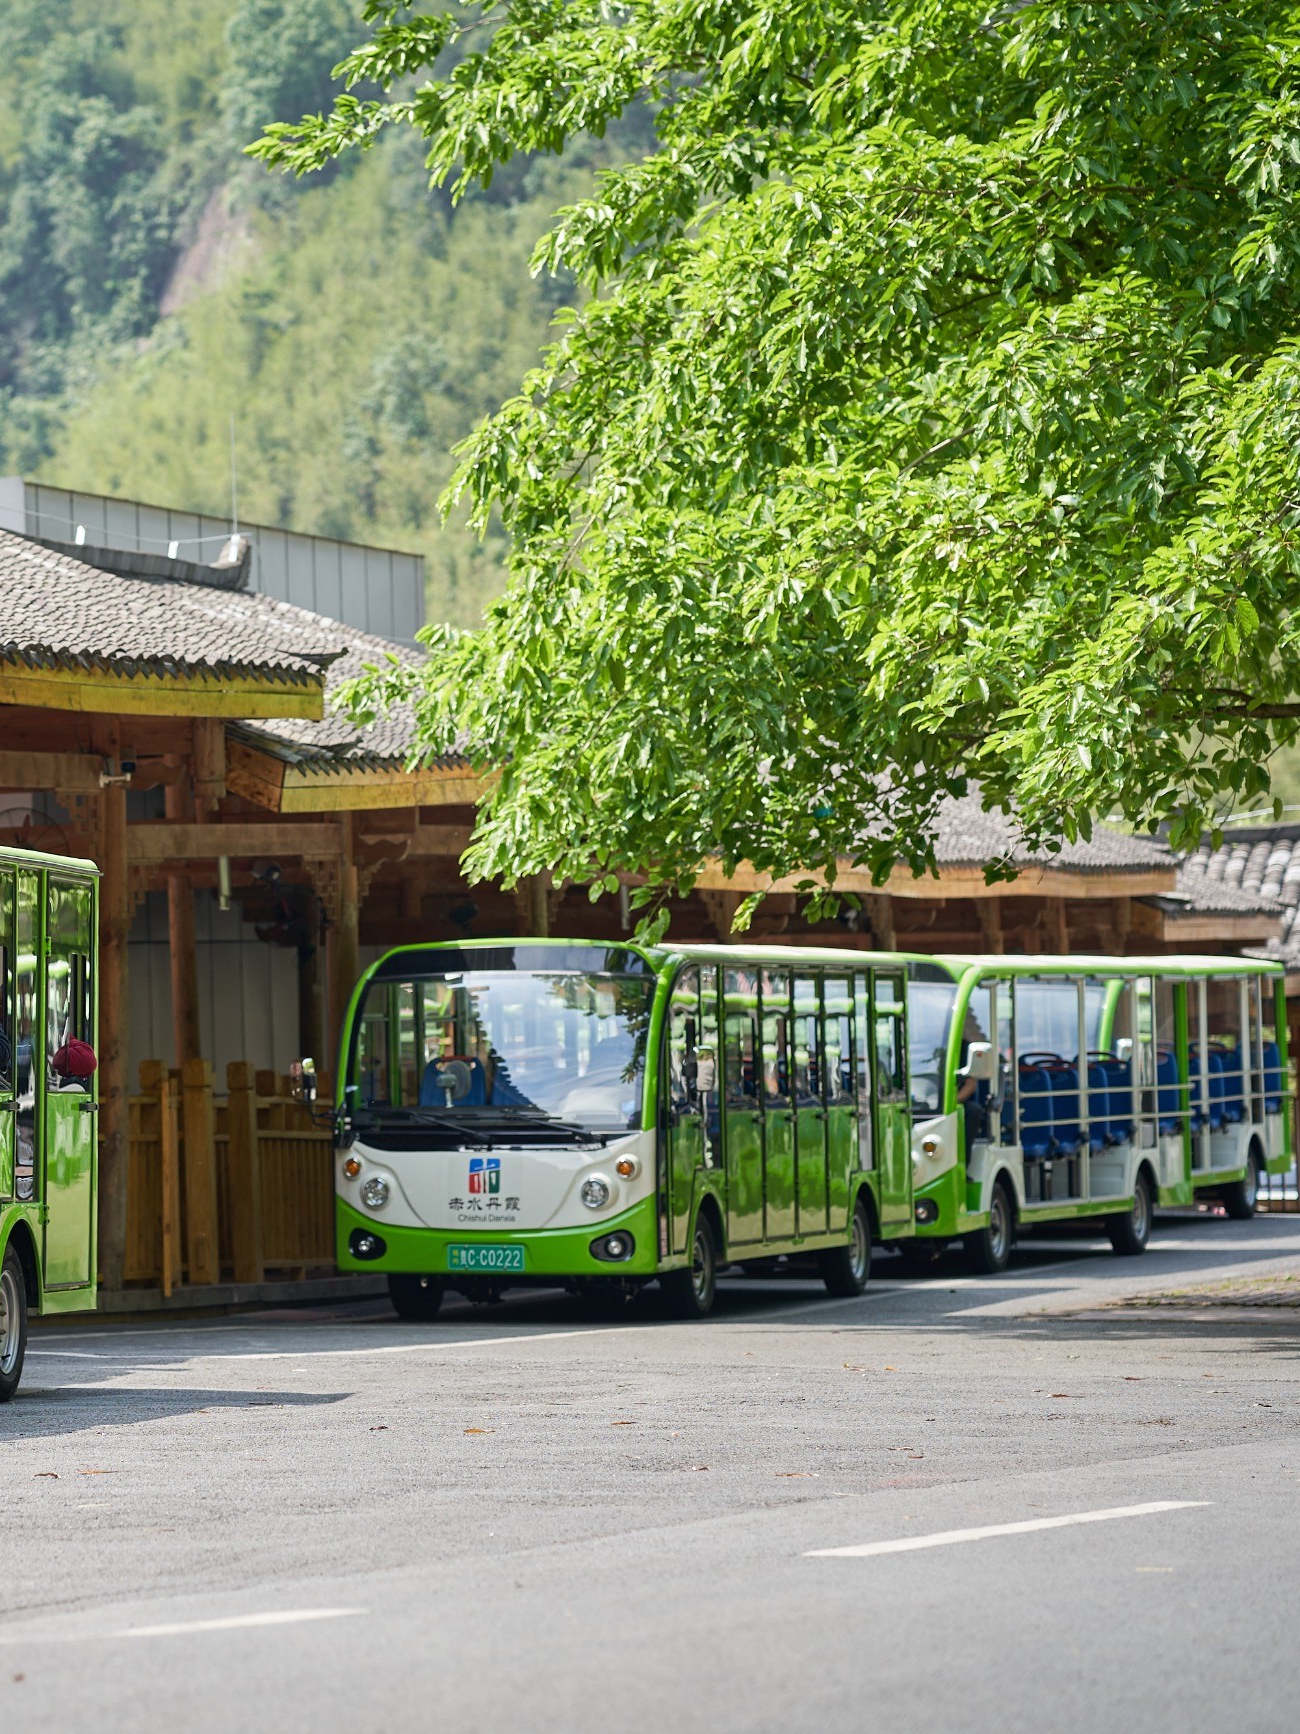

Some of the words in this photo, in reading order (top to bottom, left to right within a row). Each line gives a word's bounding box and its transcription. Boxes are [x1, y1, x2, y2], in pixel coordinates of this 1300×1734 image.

[449, 1197, 520, 1211] 赤水丹霞
[458, 1214, 487, 1222] Chishui
[488, 1214, 515, 1222] Danxia
